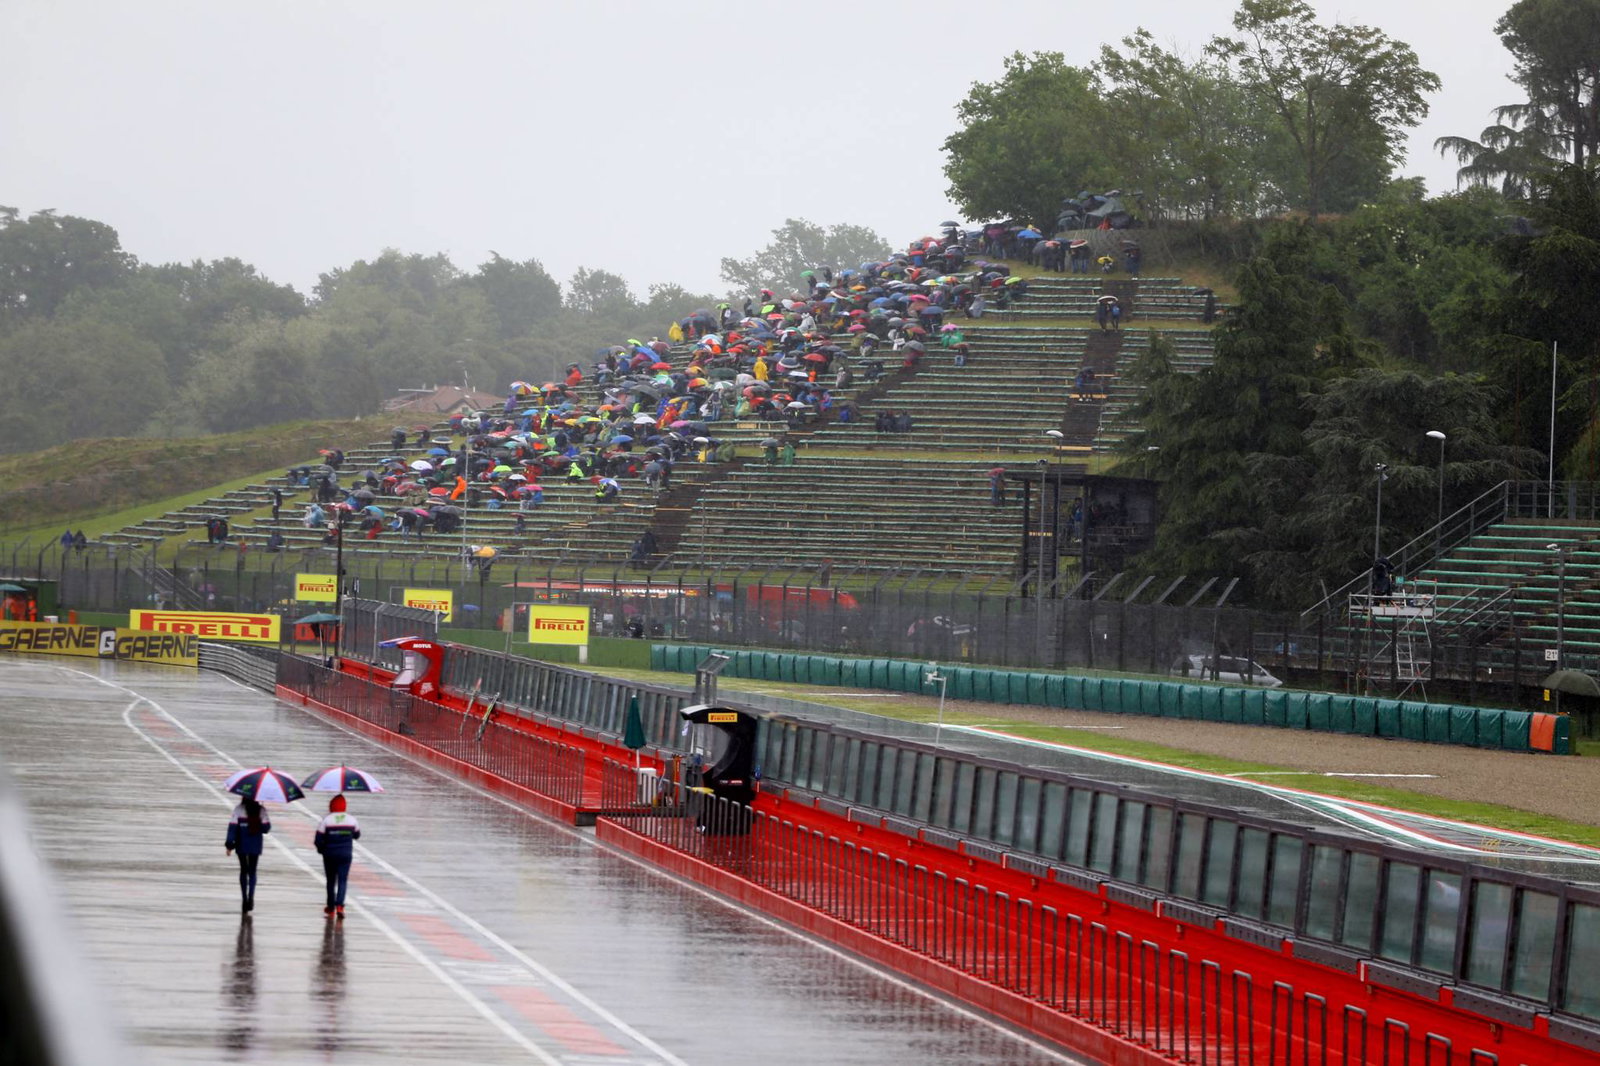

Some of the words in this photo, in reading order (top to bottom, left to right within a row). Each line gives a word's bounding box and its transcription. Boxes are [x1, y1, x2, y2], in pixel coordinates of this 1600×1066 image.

[140, 612, 272, 638] PIRELLI
[535, 618, 585, 631] PIRELLI
[0, 626, 98, 650] GAERNE
[116, 635, 198, 659] GAERNE
